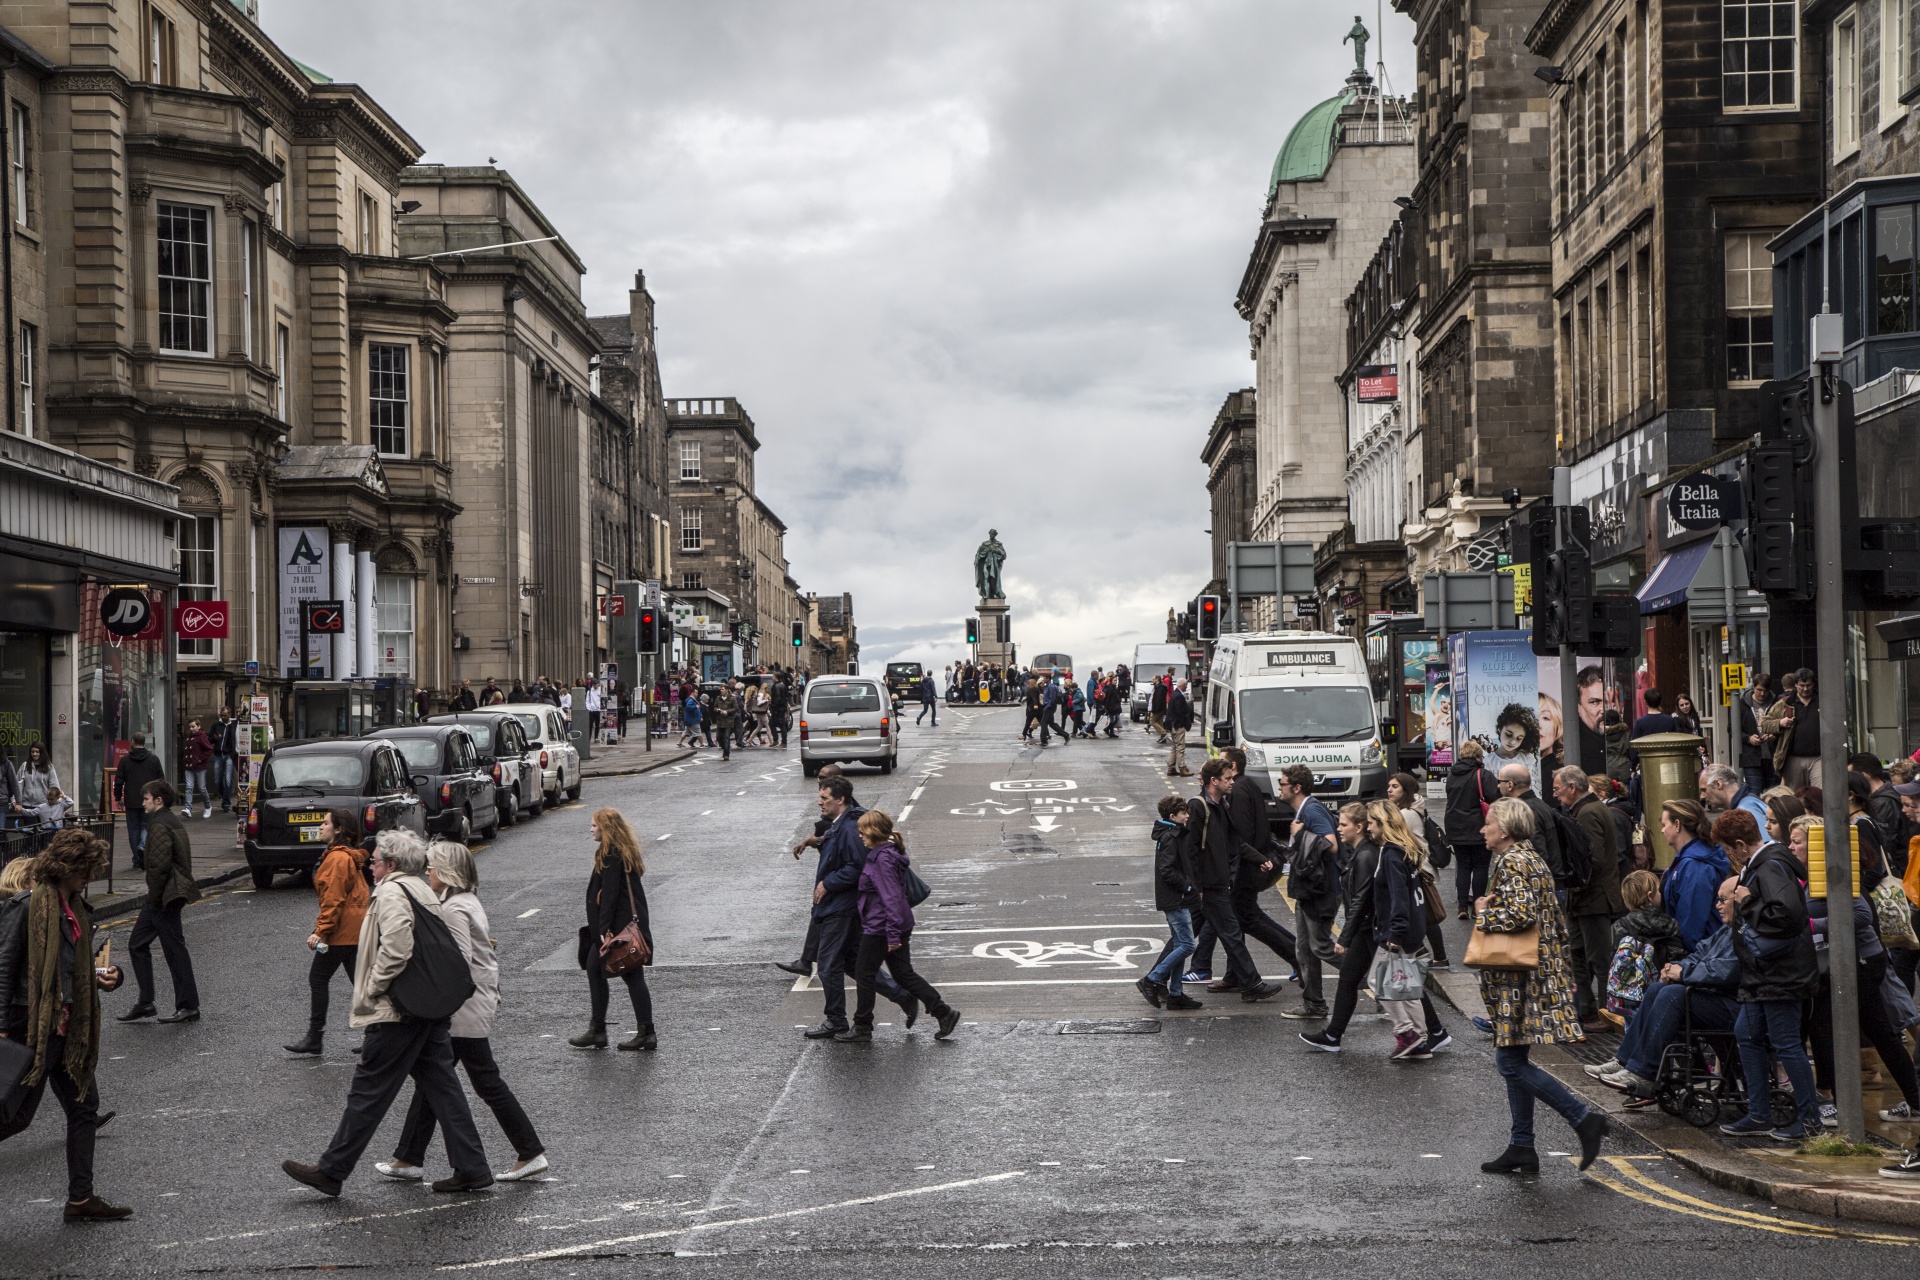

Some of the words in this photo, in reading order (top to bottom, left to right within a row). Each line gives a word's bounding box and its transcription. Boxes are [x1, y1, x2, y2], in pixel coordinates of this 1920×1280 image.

[1679, 485, 1719, 501] Bella
[1679, 504, 1720, 520] Italia
[289, 530, 323, 565] A
[1520, 568, 1530, 576] LE
[108, 600, 144, 623] JD
[185, 612, 203, 628] Virgin
[1272, 653, 1330, 664] AMBULANCE
[1492, 651, 1516, 661] THE
[1482, 663, 1506, 671] BLUE
[1510, 662, 1530, 671] BOX
[1474, 684, 1534, 694] MEMORIES
[1474, 694, 1492, 705] OF
[1495, 696, 1515, 705] THE
[966, 797, 1117, 805] ONLY
[950, 804, 1137, 816] AHEAD
